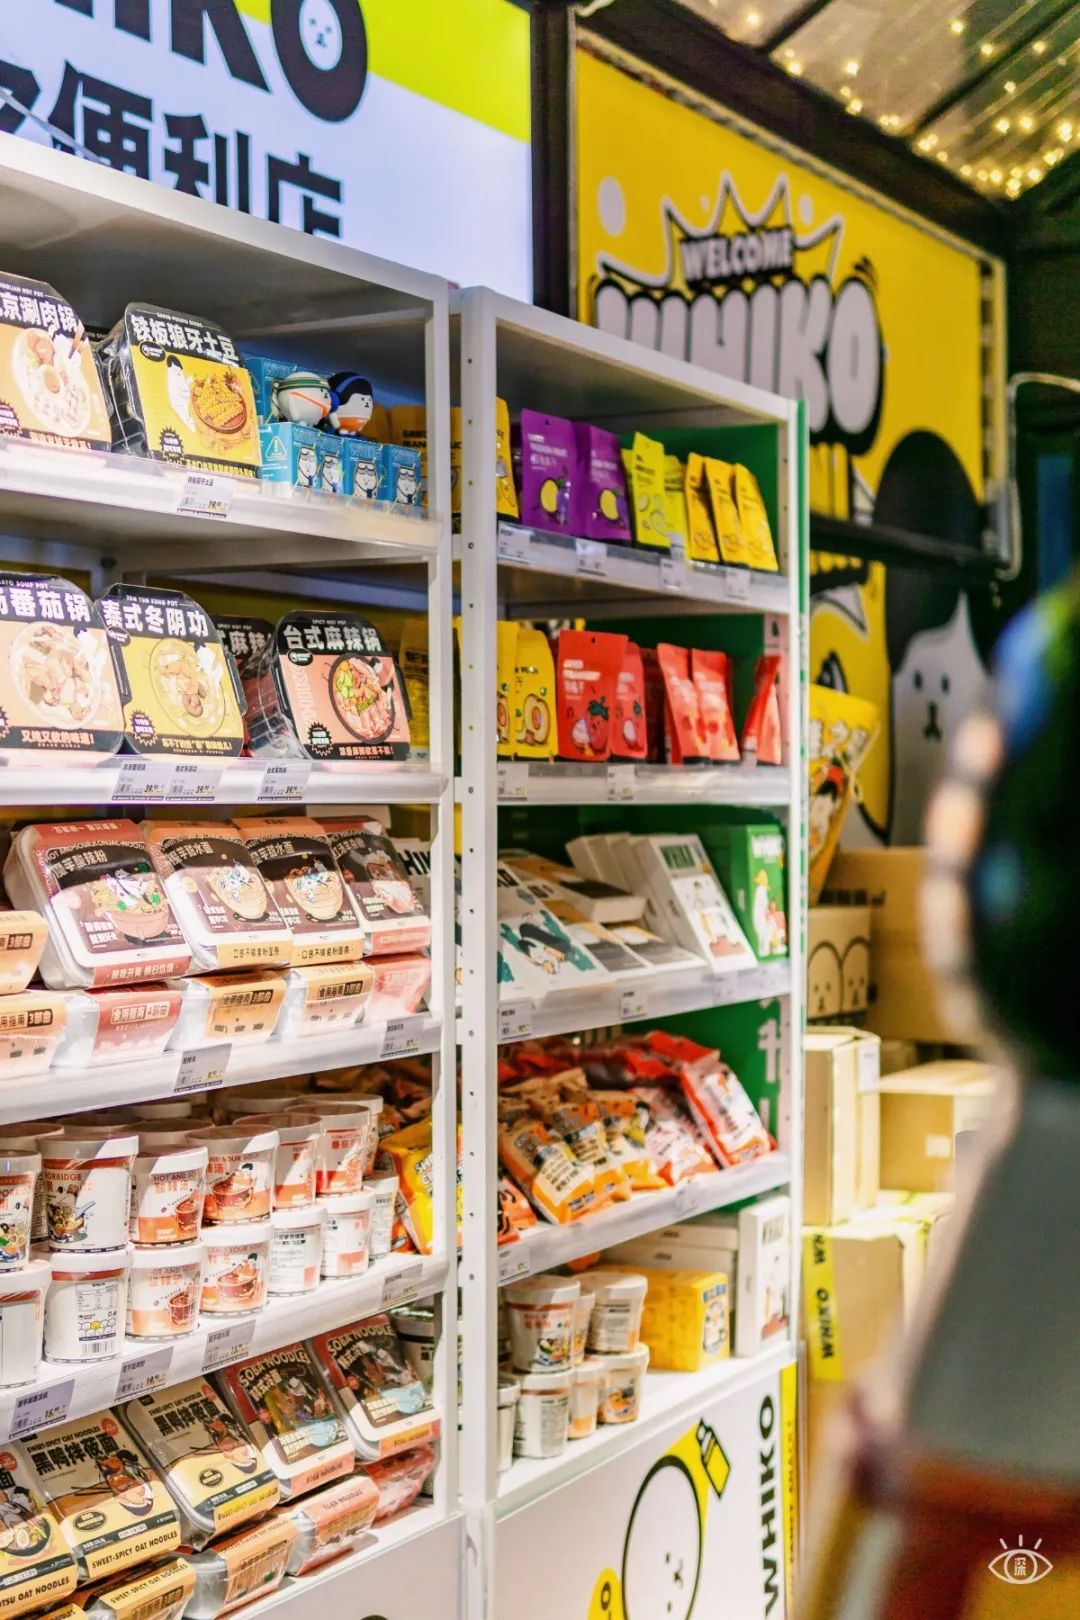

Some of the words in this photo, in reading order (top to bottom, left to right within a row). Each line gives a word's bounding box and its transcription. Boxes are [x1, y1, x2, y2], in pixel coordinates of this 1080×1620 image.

[682, 229, 794, 279] WELCOME
[0, 293, 77, 332] 京涮肉锅
[131, 313, 239, 360] 铁板狼牙土豆
[101, 598, 209, 637] 泰式冬阴功
[218, 628, 272, 655] 麻辣
[284, 624, 382, 651] 台式麻辣锅
[51, 849, 108, 878] 魔芋酸辣粉
[239, 1360, 267, 1386] SOBA
[759, 1394, 779, 1618] WHIKO
[92, 1547, 133, 1569] SWEET-SPICY
[135, 1541, 148, 1554] OAT
[149, 1530, 178, 1549] NOODLES
[18, 1587, 33, 1602] OAT
[35, 1576, 70, 1597] NOODLES
